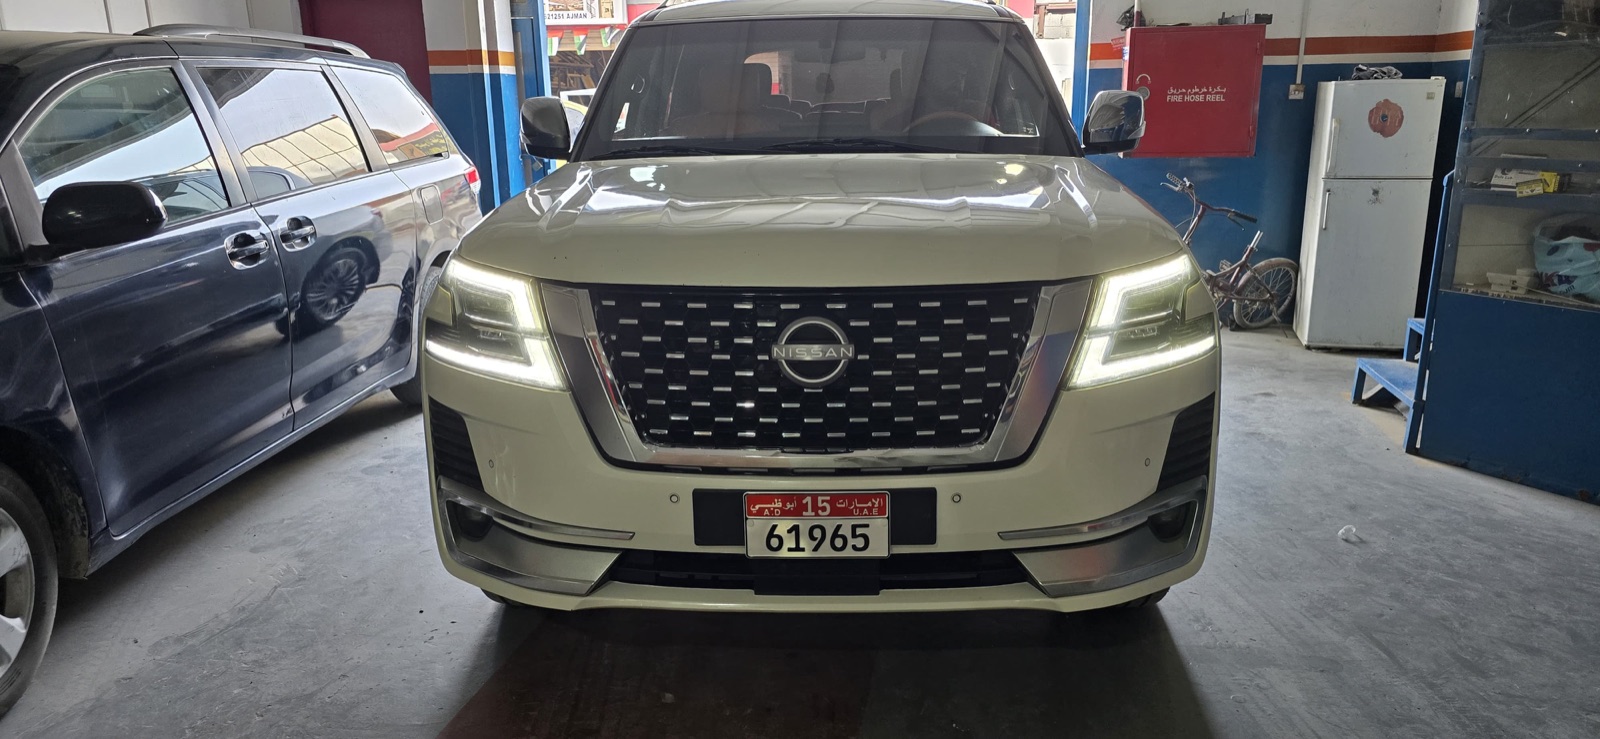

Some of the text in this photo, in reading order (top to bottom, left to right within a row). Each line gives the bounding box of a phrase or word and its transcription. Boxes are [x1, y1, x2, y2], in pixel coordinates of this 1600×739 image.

[1167, 86, 1227, 95] بكرة خرطوم حريق
[1206, 94, 1226, 102] REEL
[773, 347, 853, 358] NISSAN
[750, 496, 797, 513] أبو ظبي
[802, 496, 831, 516] 15
[765, 523, 870, 552] 61965
